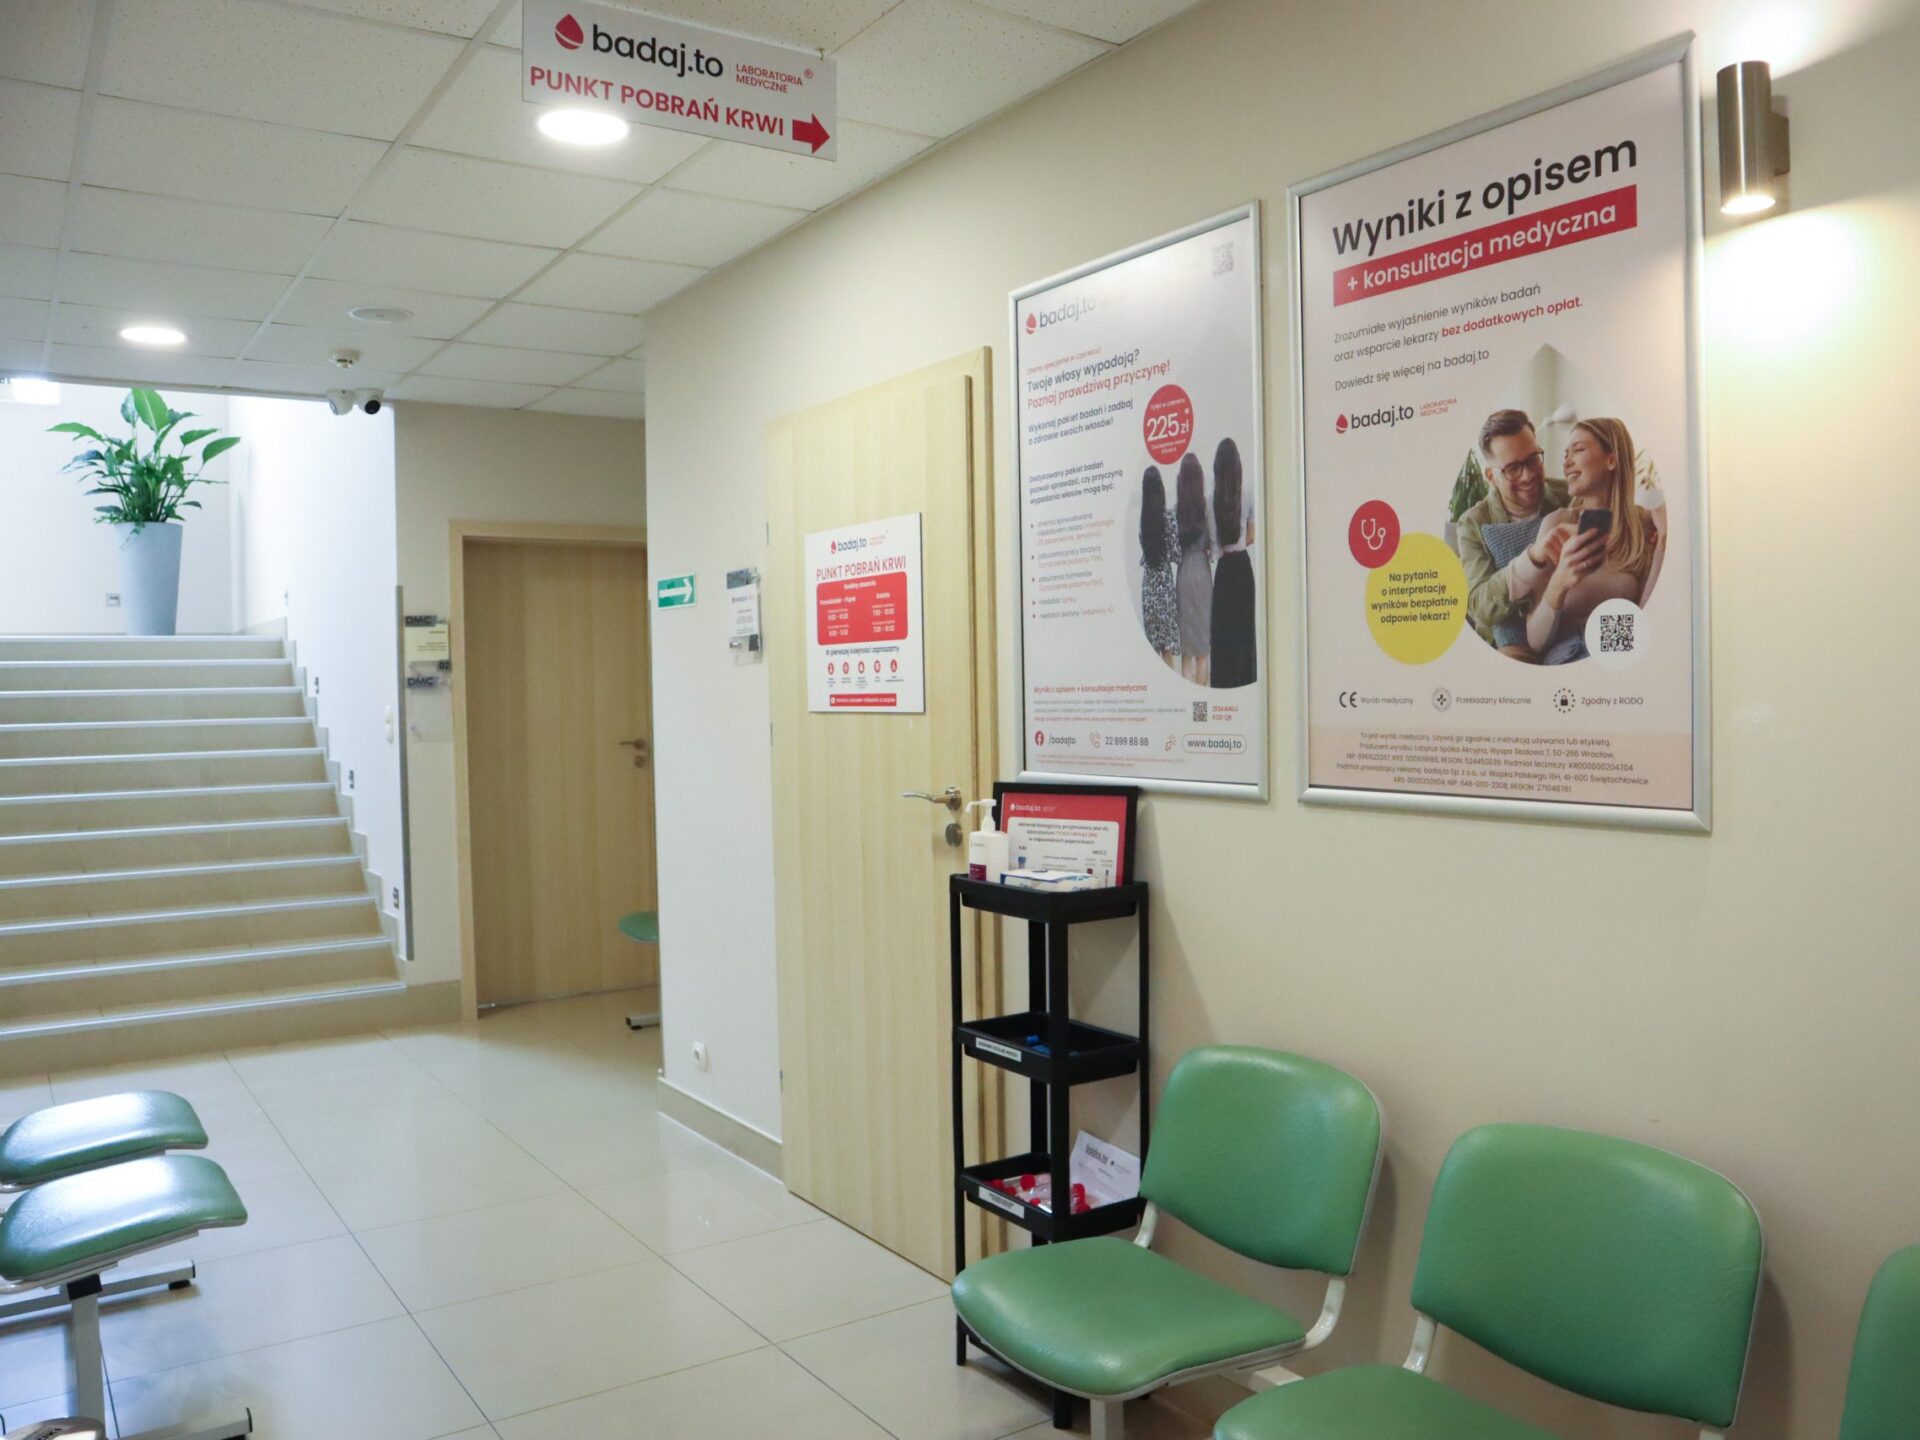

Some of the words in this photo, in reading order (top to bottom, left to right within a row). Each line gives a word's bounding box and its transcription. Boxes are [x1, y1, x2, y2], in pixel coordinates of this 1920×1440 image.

[592, 24, 724, 77] badaj.to
[735, 74, 788, 93] MEDYCZNE
[530, 66, 613, 101] PUNKT
[620, 85, 719, 122] POBRAŃ
[725, 106, 784, 136] KRWI
[1332, 189, 1445, 256] Wyniki
[1455, 190, 1472, 219] z
[1482, 139, 1637, 215] opisem
[1347, 277, 1358, 291] +
[1363, 240, 1483, 288] konsultacja
[1489, 205, 1616, 254] medyczna
[1039, 295, 1097, 328] badaj.to
[1334, 321, 1386, 343] Zrozumiałe
[1387, 306, 1449, 331] wyjaśnienie
[1450, 295, 1498, 316] wyników
[1500, 284, 1541, 303] badań
[1334, 350, 1354, 362] oraz
[1356, 338, 1401, 358] wsparcie
[1403, 331, 1440, 347] lekarzy
[1441, 324, 1460, 338] bez
[1463, 305, 1544, 333] dodatkowych
[1547, 296, 1583, 316] opłat.
[1027, 376, 1053, 393] Twoje
[1054, 367, 1082, 386] włosy
[1083, 349, 1140, 377] wypadają?
[1335, 374, 1374, 391] Dowiedz
[1376, 369, 1391, 385] się
[1392, 362, 1425, 377] więcej
[1427, 359, 1442, 370] na
[1444, 348, 1490, 369] badaj.to
[1027, 393, 1057, 410] Poznaj
[1058, 378, 1111, 405] prawdziwą
[1113, 359, 1171, 390] przyczynę!
[1028, 418, 1057, 434] Wykonaj
[1057, 412, 1079, 427] pakiet
[1079, 407, 1103, 419] badań
[1108, 398, 1133, 414] zadbaj
[1147, 412, 1180, 441] 225
[1180, 419, 1189, 434] zł
[1350, 404, 1414, 429] badaj.to
[1033, 431, 1058, 445] zdrowie
[1060, 425, 1084, 438] swoich
[837, 537, 867, 552] badaj.to
[816, 565, 843, 580] PUNKT
[844, 556, 881, 577] POBRAŃ
[882, 556, 907, 571] KRWI
[1389, 572, 1401, 583] Na
[1402, 569, 1438, 584] pytania
[1371, 597, 1408, 612] wyników
[1410, 595, 1458, 610] bezpłatnie
[1381, 587, 1387, 596] o
[1389, 583, 1447, 600] interpretację
[1380, 613, 1418, 627] odpowie
[1419, 610, 1450, 623] lekarz!
[1456, 696, 1497, 707] Przebadany
[1498, 696, 1531, 705] klinicznie
[1580, 696, 1610, 707] Zgodny
[1618, 696, 1644, 706] RODO
[1105, 736, 1114, 746] 22
[1114, 736, 1128, 746] 899
[1187, 738, 1242, 751] www.badaj.to
